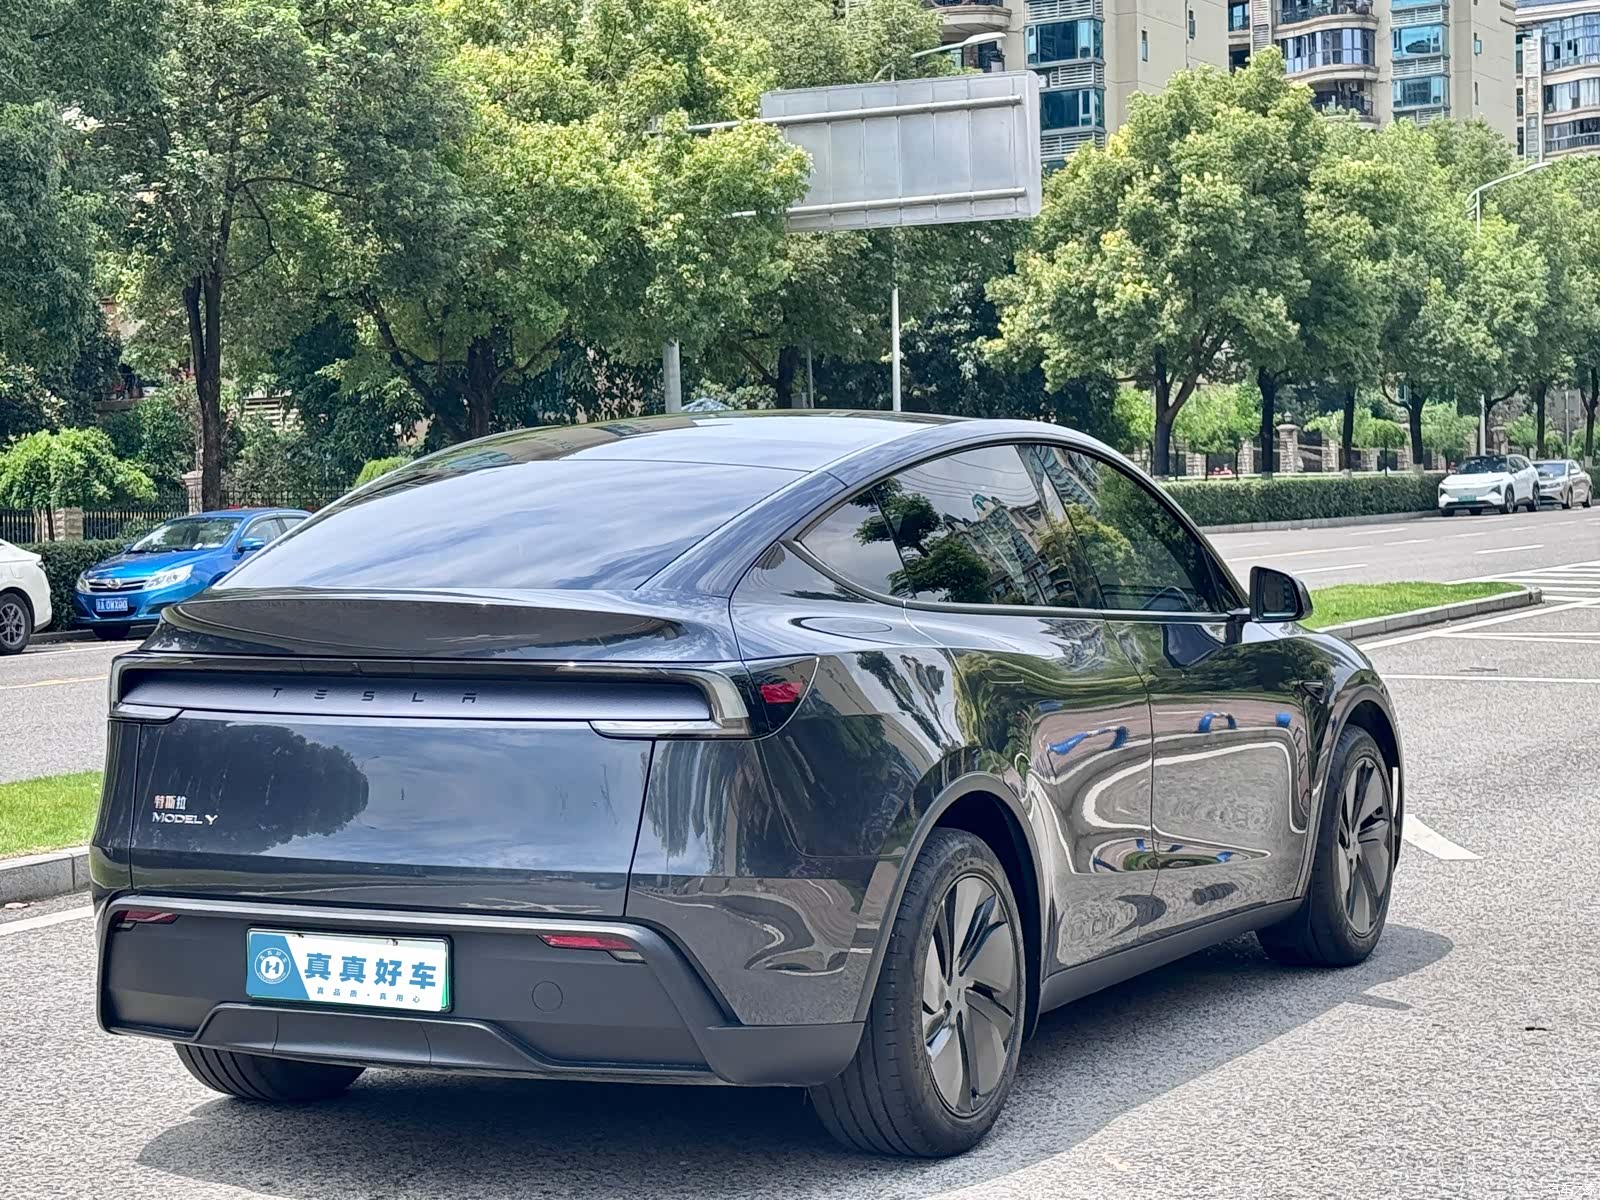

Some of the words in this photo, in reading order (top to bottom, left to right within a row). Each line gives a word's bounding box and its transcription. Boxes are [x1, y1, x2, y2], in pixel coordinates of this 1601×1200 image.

[273, 687, 477, 703] TESLA
[154, 795, 187, 810] 特斯拉
[152, 812, 203, 825] MODEL
[205, 814, 218, 825] Y
[304, 952, 437, 990] 真真好车
